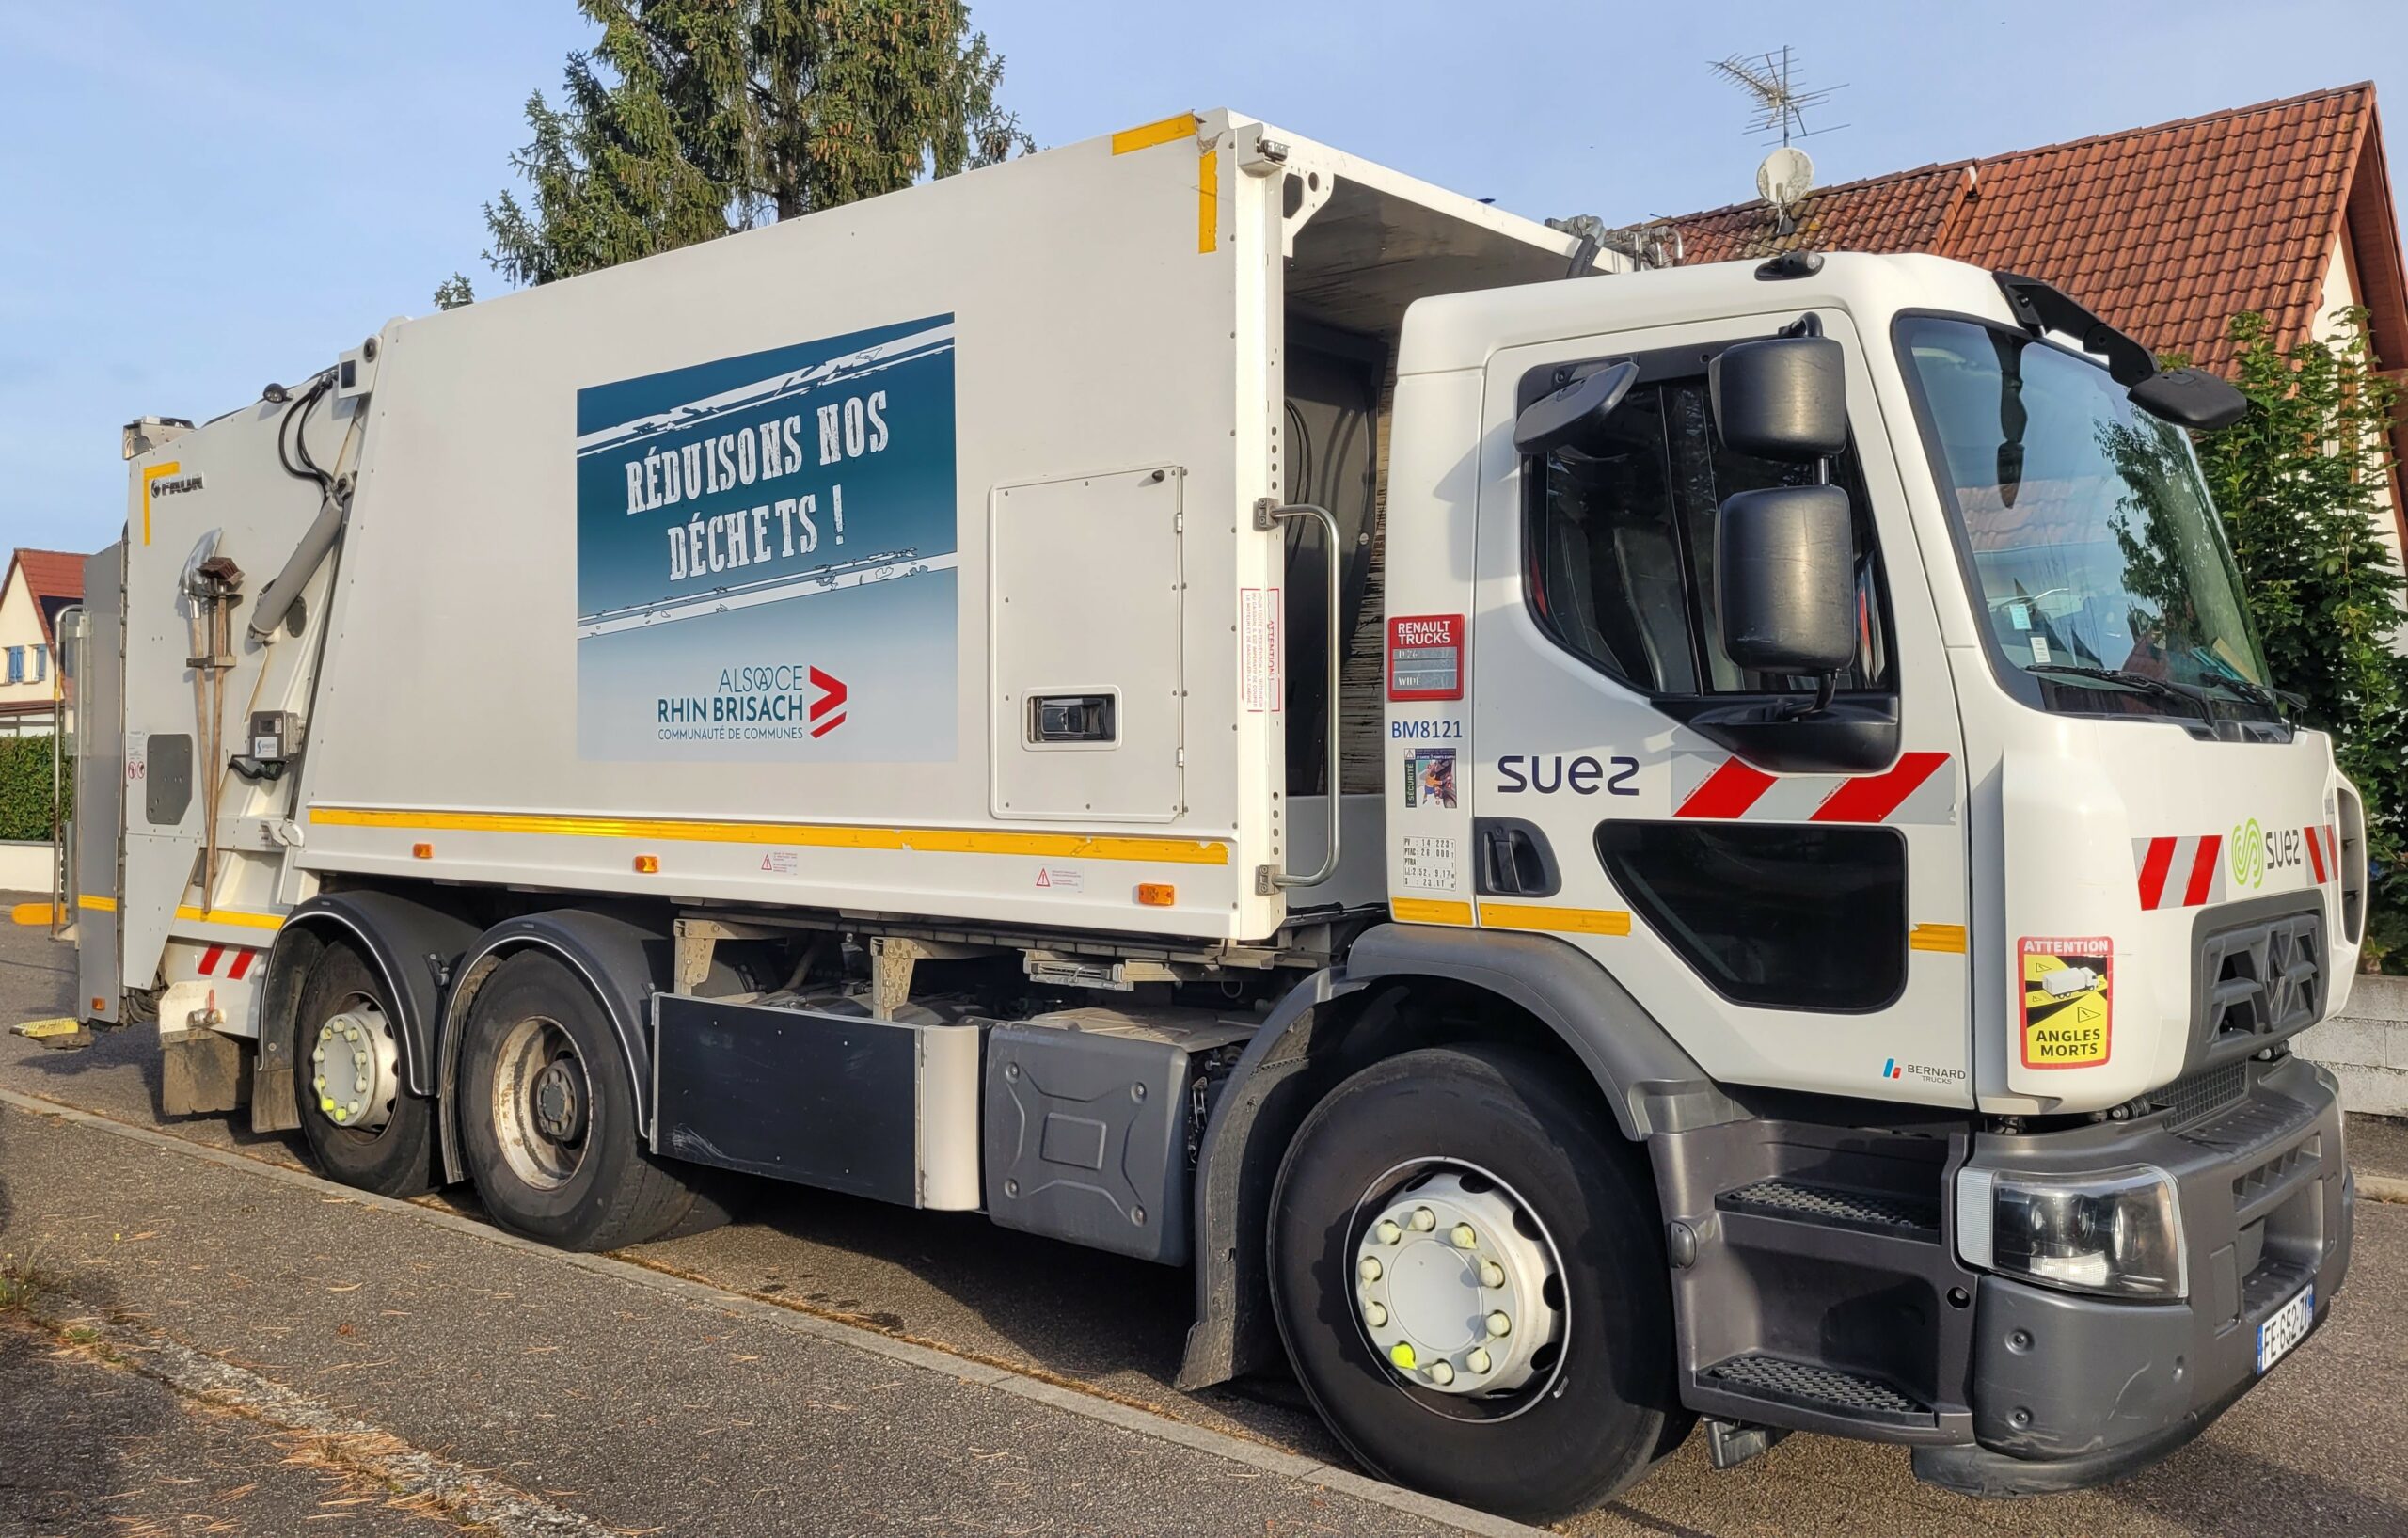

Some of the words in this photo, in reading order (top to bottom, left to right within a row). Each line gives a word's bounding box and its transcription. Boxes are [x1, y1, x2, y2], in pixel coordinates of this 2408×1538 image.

[625, 414, 802, 515] RÉDUISONS
[816, 389, 890, 466] NOS
[667, 494, 817, 582] DÉCHETS
[832, 484, 845, 546] !
[1398, 620, 1450, 634] RENAULT
[1398, 632, 1450, 645] TRUCKS
[658, 697, 707, 723] RHIN
[713, 694, 803, 722] BRISACH
[658, 725, 725, 740] COMMUNAUTÉ
[728, 728, 741, 739] DE
[744, 727, 803, 739] COMMUNES
[1391, 720, 1463, 738] BM8121
[1406, 763, 1415, 801] SÉCURITÉ
[2024, 941, 2108, 953] ATTENTION
[2036, 1028, 2100, 1042] ANGLES
[2041, 1042, 2098, 1057] MORTS
[1908, 1064, 1966, 1080] BERNARD
[1922, 1075, 1953, 1085] TRUCKS
